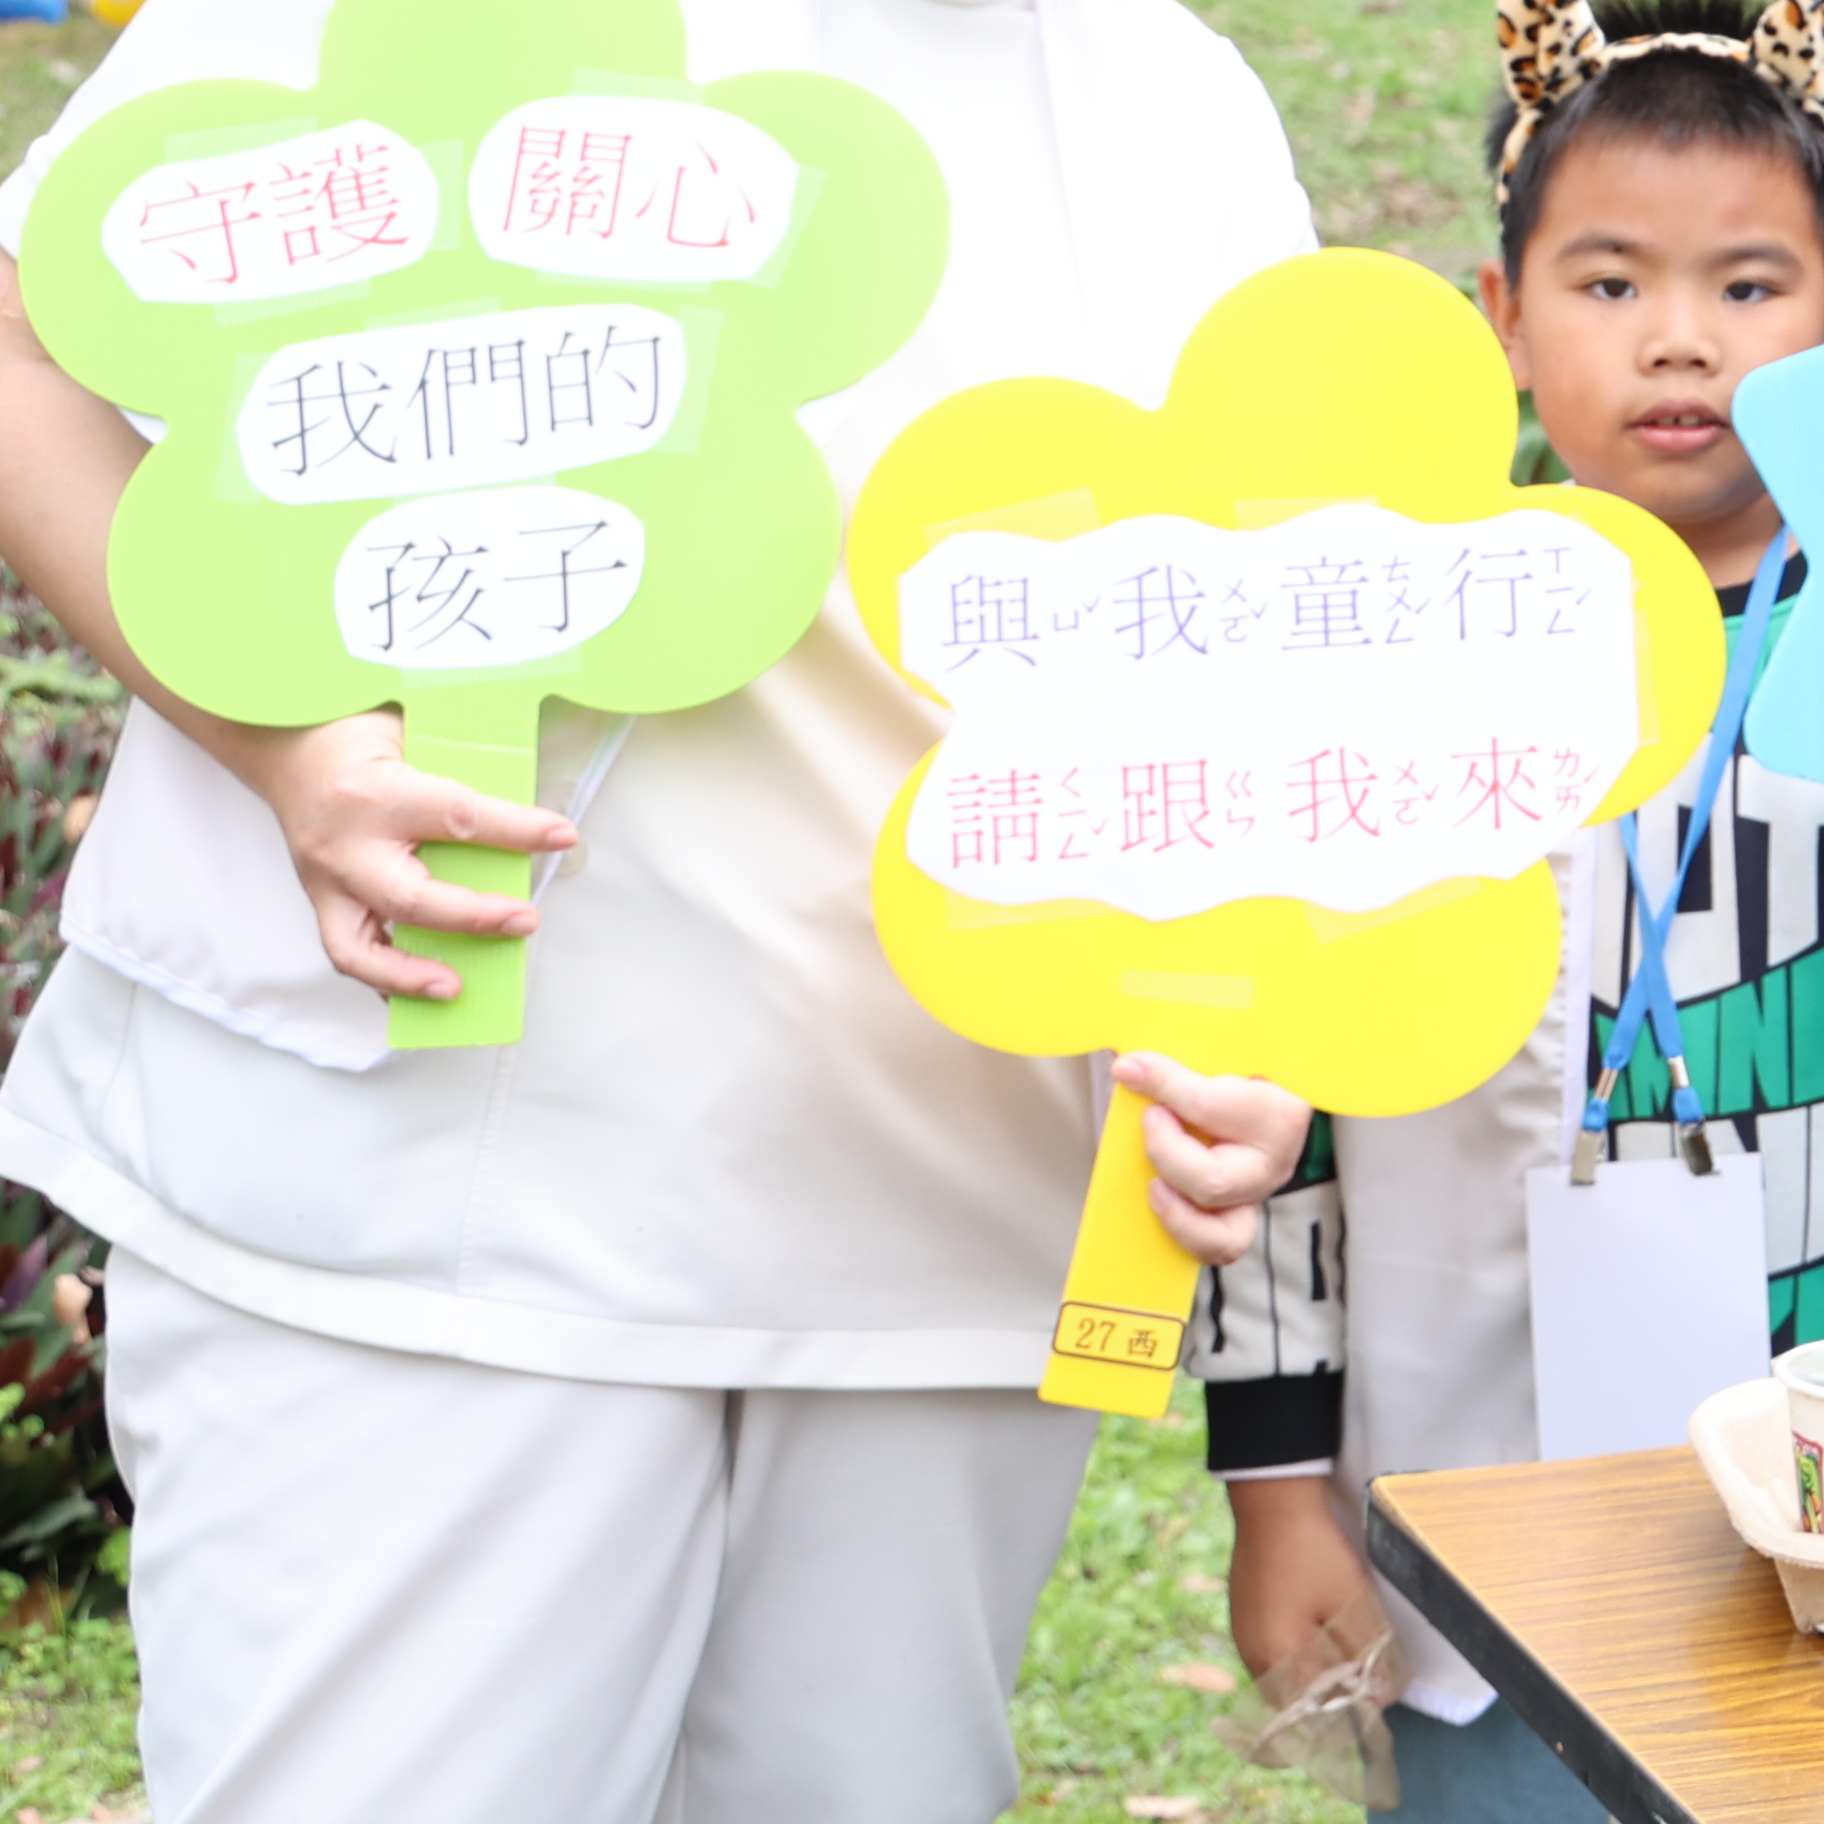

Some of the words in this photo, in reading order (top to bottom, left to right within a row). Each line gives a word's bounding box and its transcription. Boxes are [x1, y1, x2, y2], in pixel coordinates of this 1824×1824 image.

[139, 144, 409, 285] 守護
[501, 126, 756, 251] 關心
[266, 325, 664, 476] 我們的
[365, 520, 629, 652] 孩子
